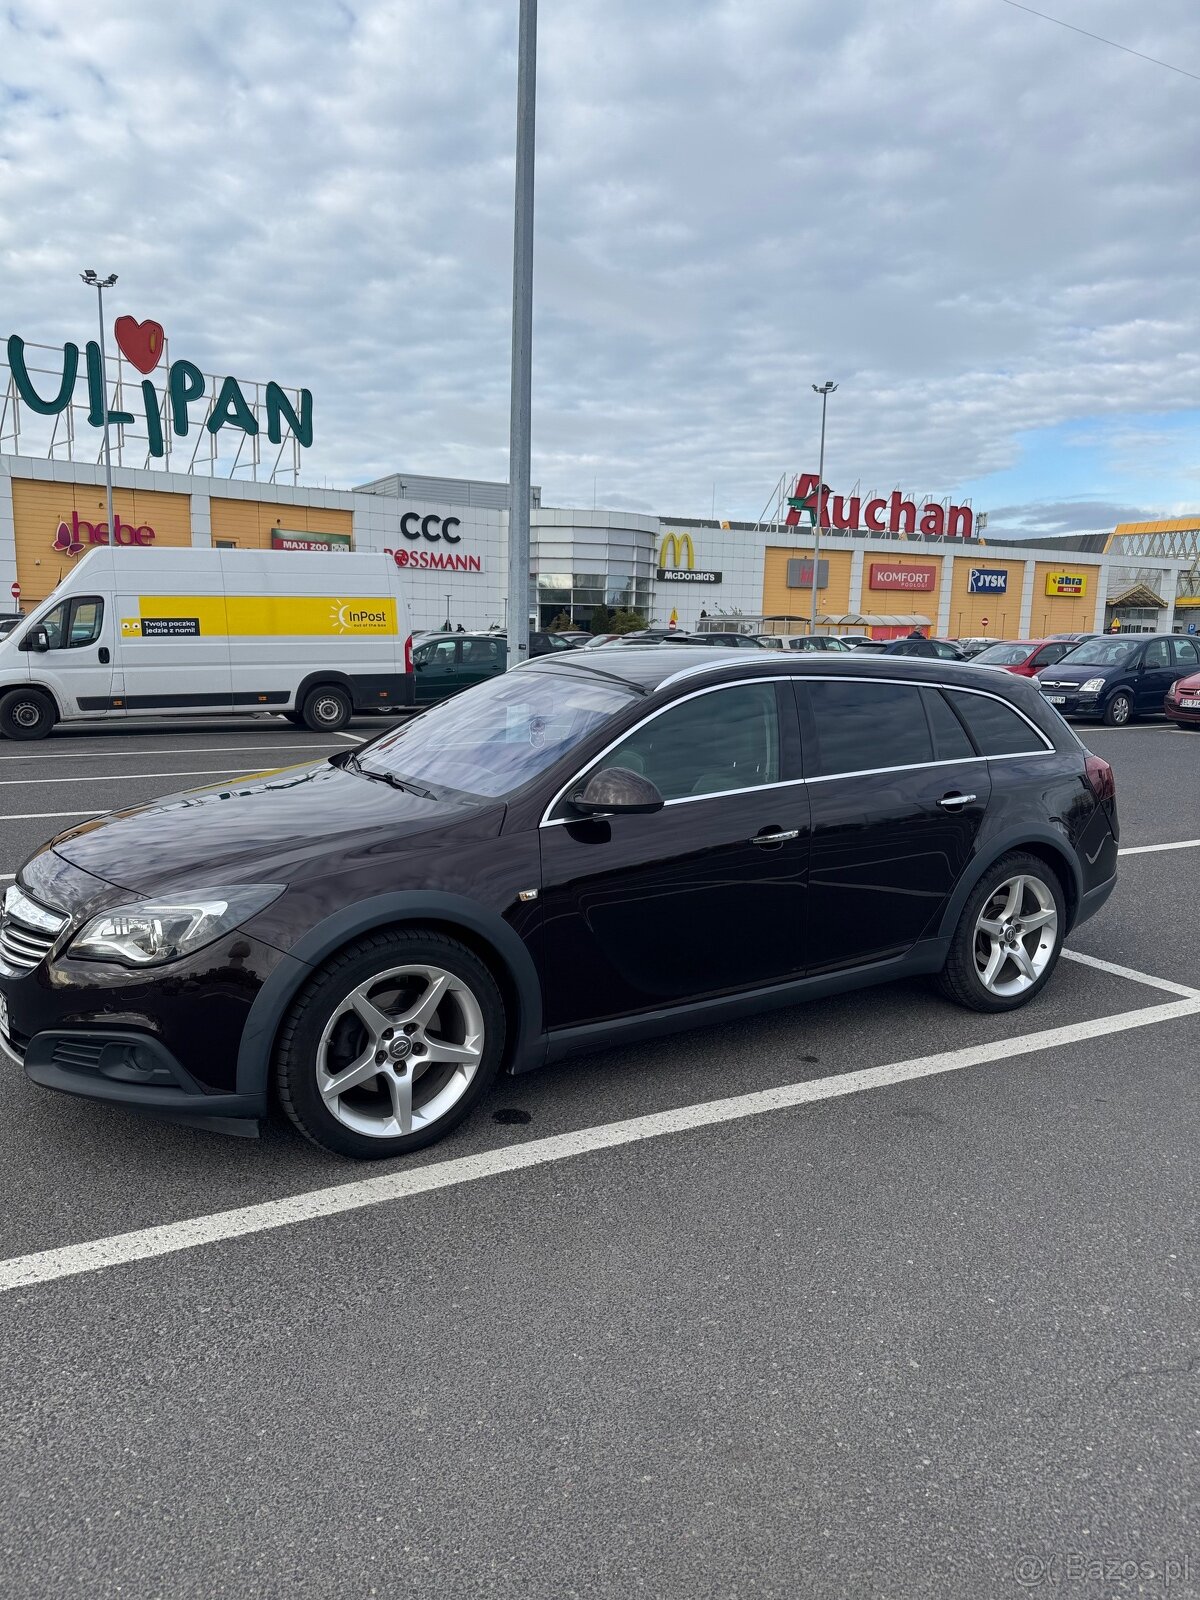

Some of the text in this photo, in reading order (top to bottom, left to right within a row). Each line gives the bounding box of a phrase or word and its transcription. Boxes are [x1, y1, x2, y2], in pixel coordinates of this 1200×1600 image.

[786, 473, 973, 538] Auchan
[72, 510, 156, 547] hebe
[400, 512, 461, 544] CCC
[283, 540, 329, 551] MAXI ZOO
[664, 571, 715, 581] McDonald's
[877, 571, 931, 584] KOMFORT
[977, 574, 1006, 588] JYSK
[1057, 575, 1083, 586] abra
[349, 610, 386, 622] InPost
